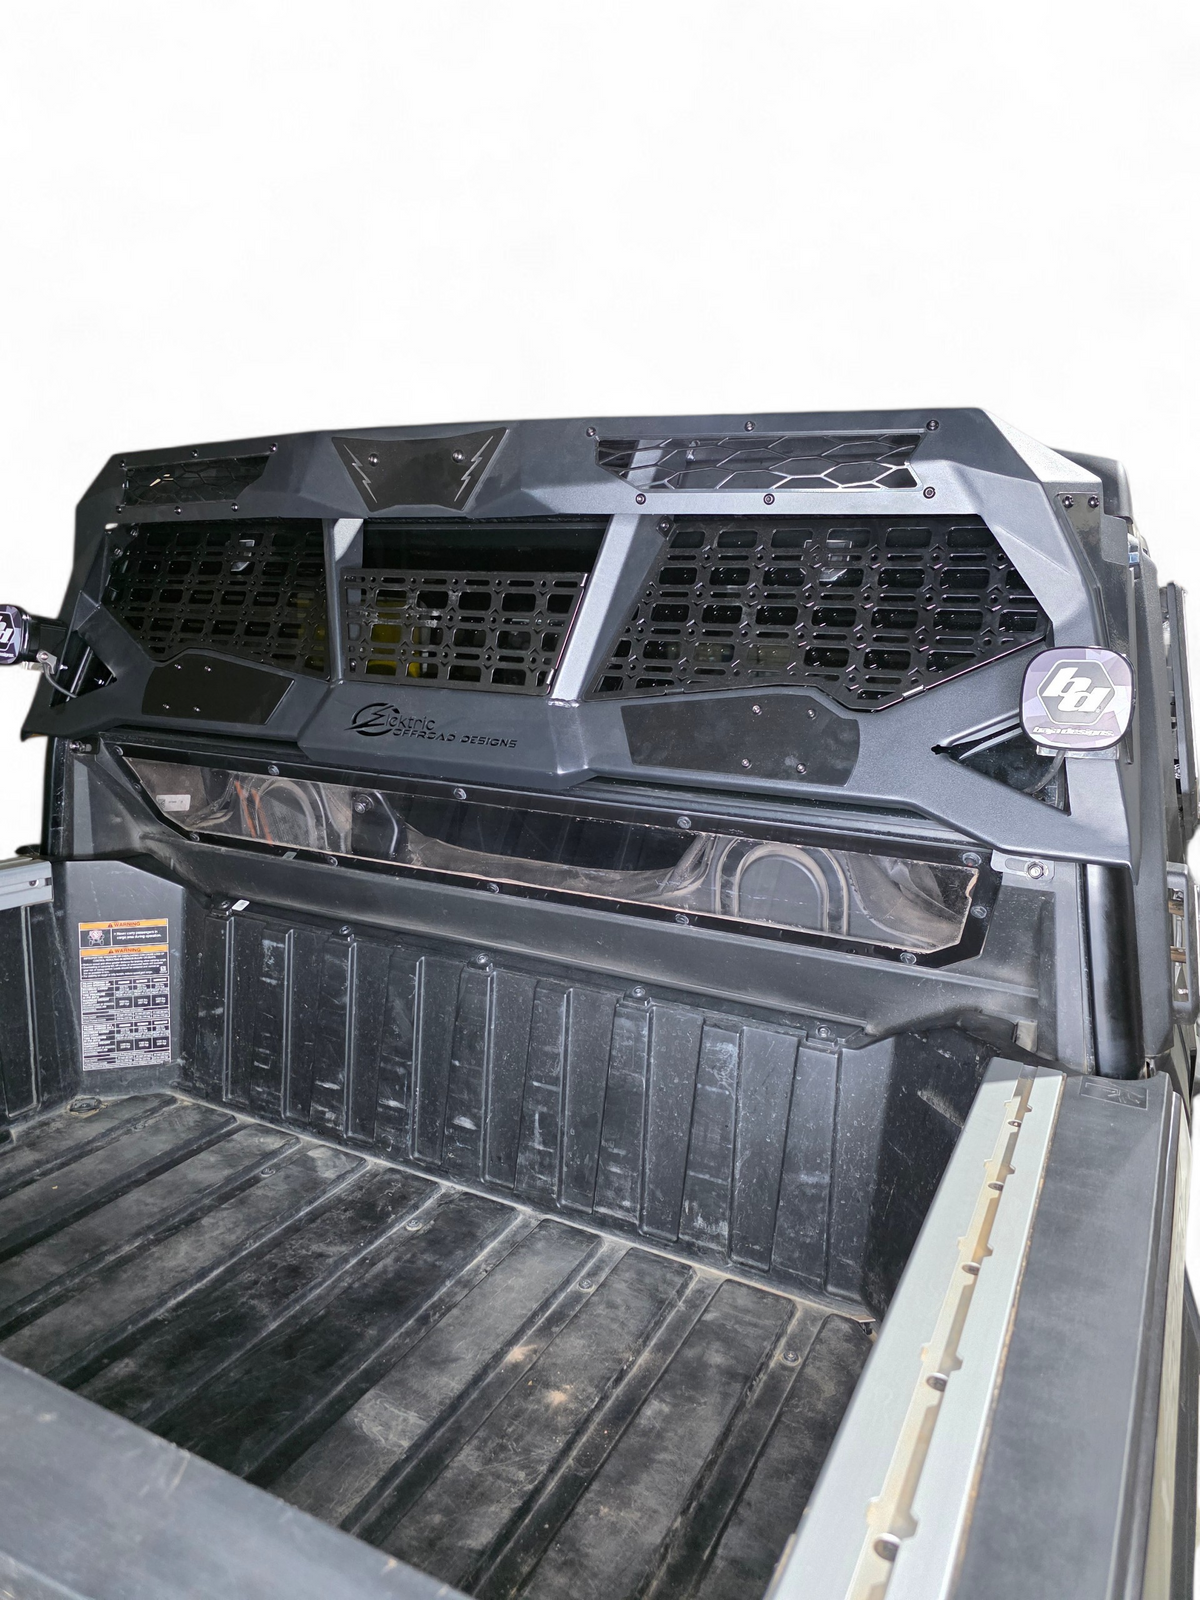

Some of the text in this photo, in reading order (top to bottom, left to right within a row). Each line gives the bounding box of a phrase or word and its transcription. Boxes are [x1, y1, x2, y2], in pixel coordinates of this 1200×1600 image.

[1042, 667, 1112, 712] bd
[393, 728, 518, 749] OFFROAD DESIGNS
[1032, 726, 1061, 735] baja
